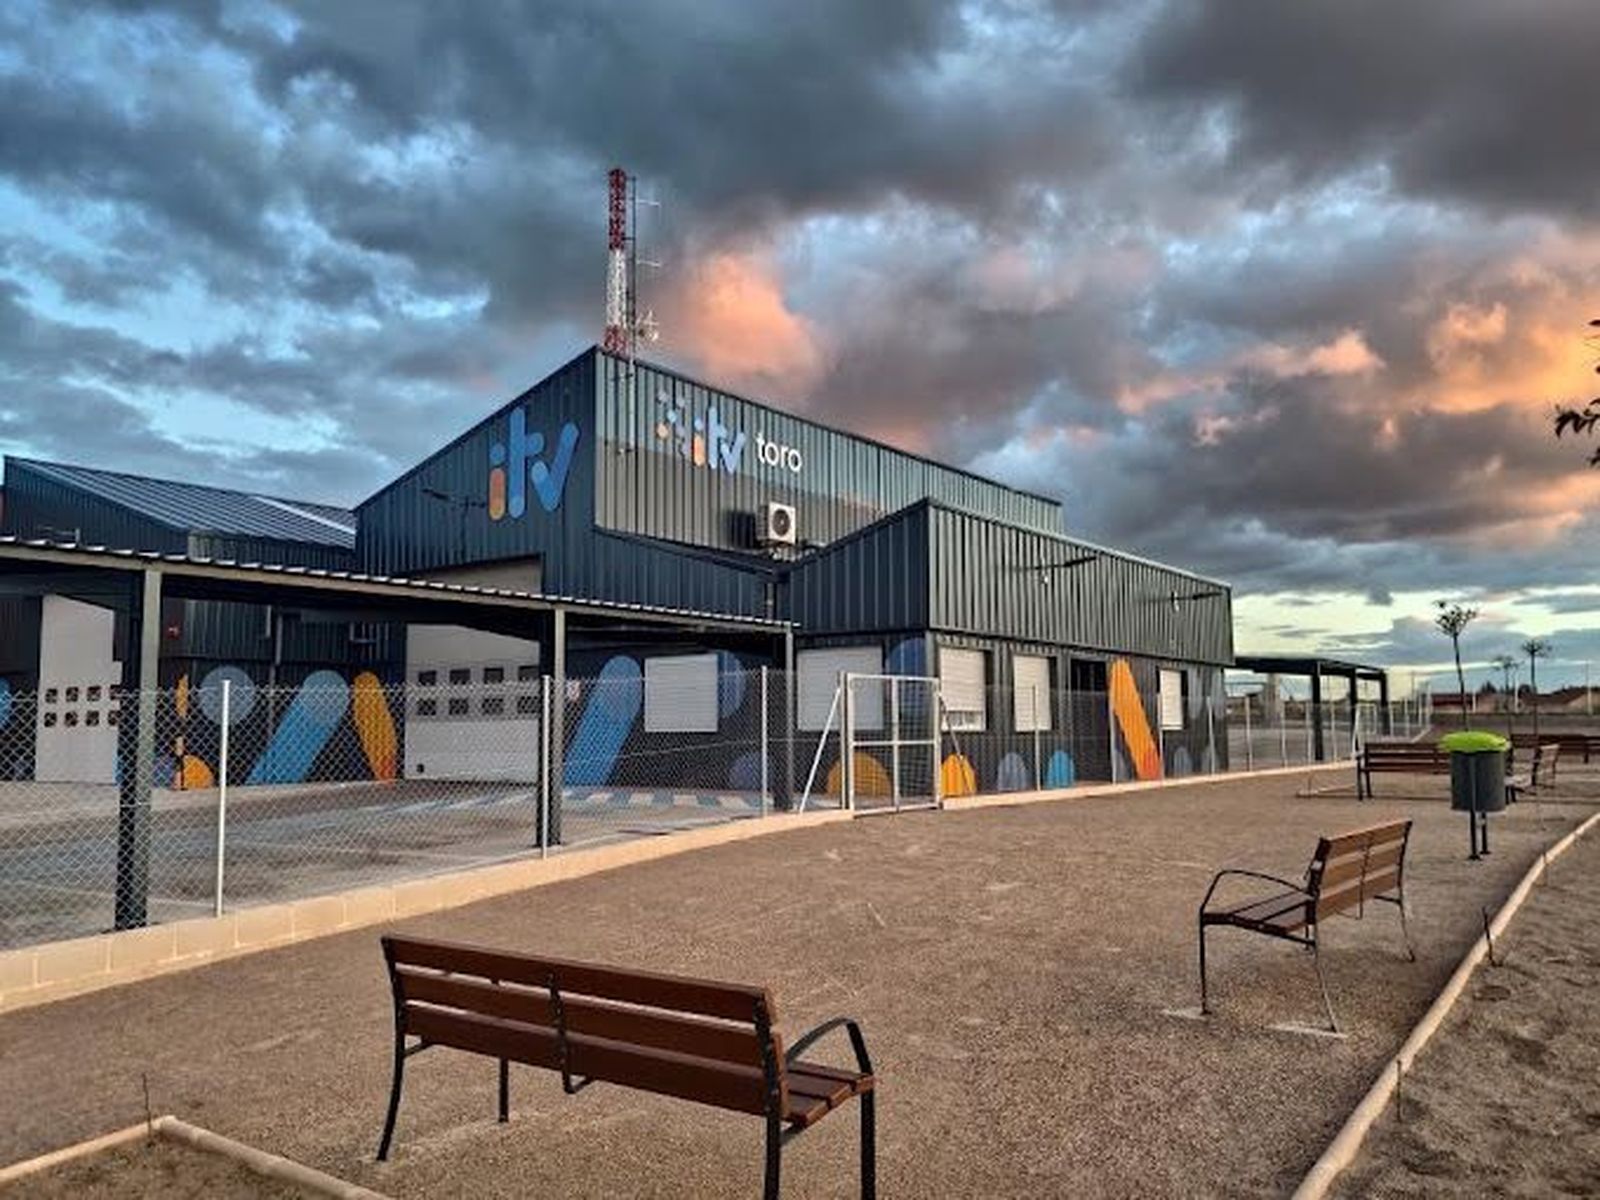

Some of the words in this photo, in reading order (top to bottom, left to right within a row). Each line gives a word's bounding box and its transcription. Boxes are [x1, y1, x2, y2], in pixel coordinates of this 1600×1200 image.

[489, 406, 580, 521] itv
[693, 405, 747, 474] itv
[756, 432, 803, 473] toro
